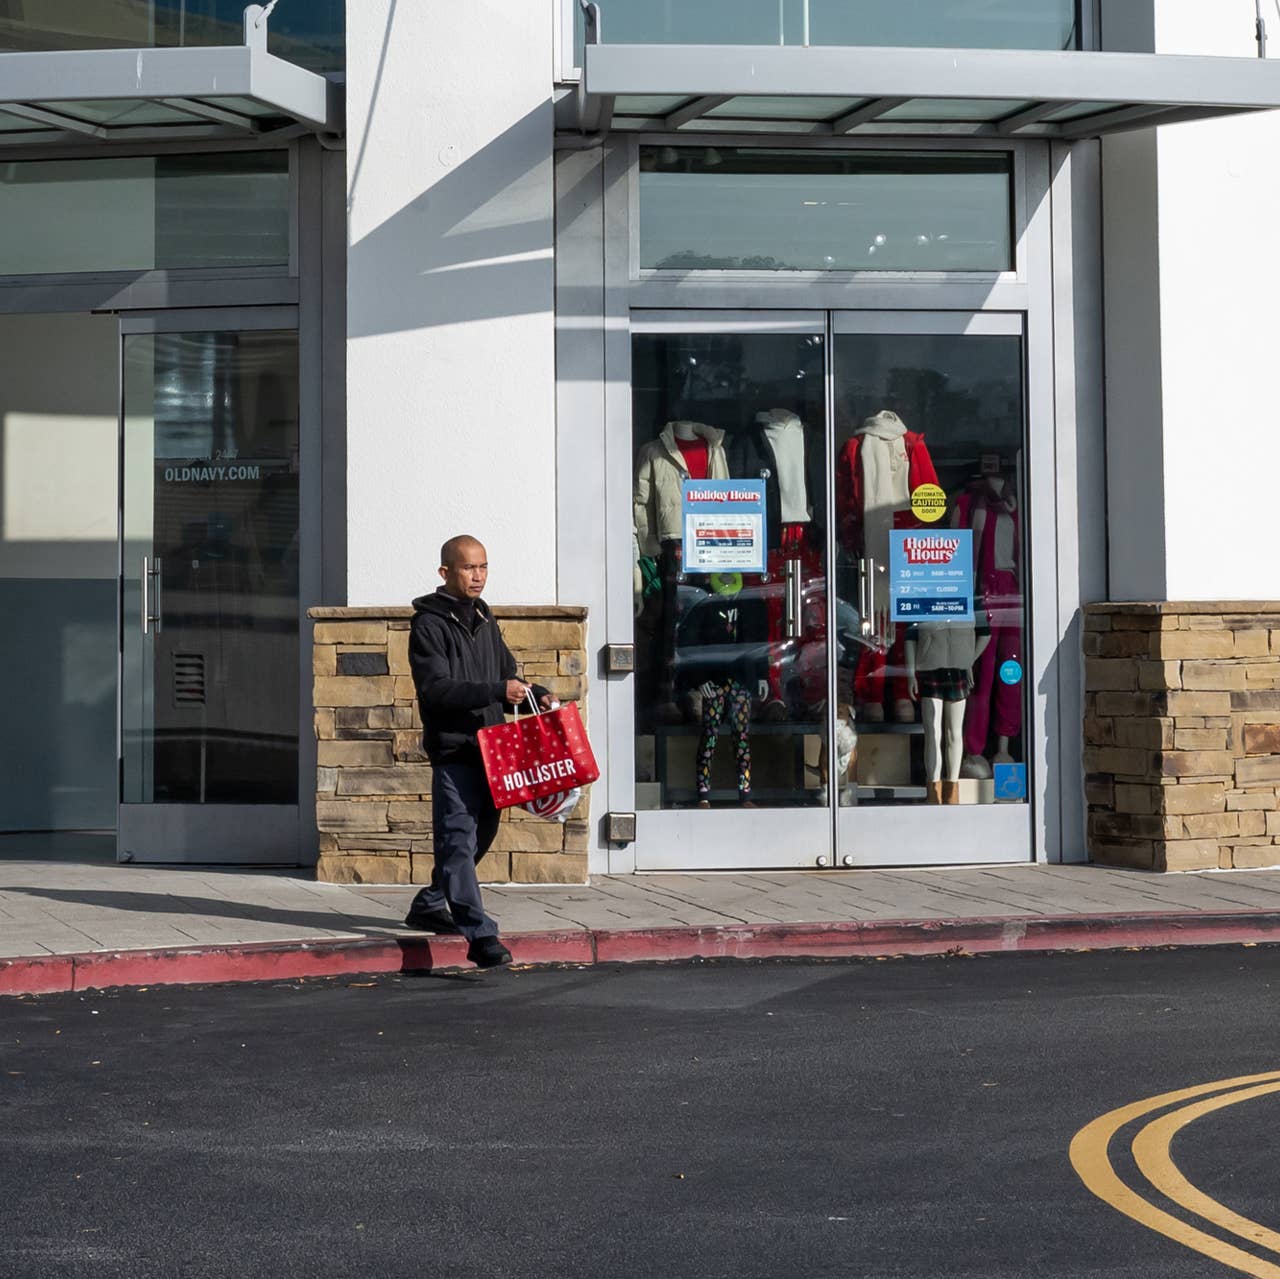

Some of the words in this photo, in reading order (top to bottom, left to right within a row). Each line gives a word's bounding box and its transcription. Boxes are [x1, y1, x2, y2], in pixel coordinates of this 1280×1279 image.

[164, 465, 261, 481] OLDNAVY.COM
[688, 490, 729, 501] Holiday
[729, 490, 761, 500] Hours
[912, 498, 945, 506] CAUTION
[906, 536, 961, 551] Holiday
[910, 548, 954, 561] Hours
[900, 585, 911, 593] 27
[900, 602, 912, 611] 28
[503, 758, 577, 792] HOLLISTER
